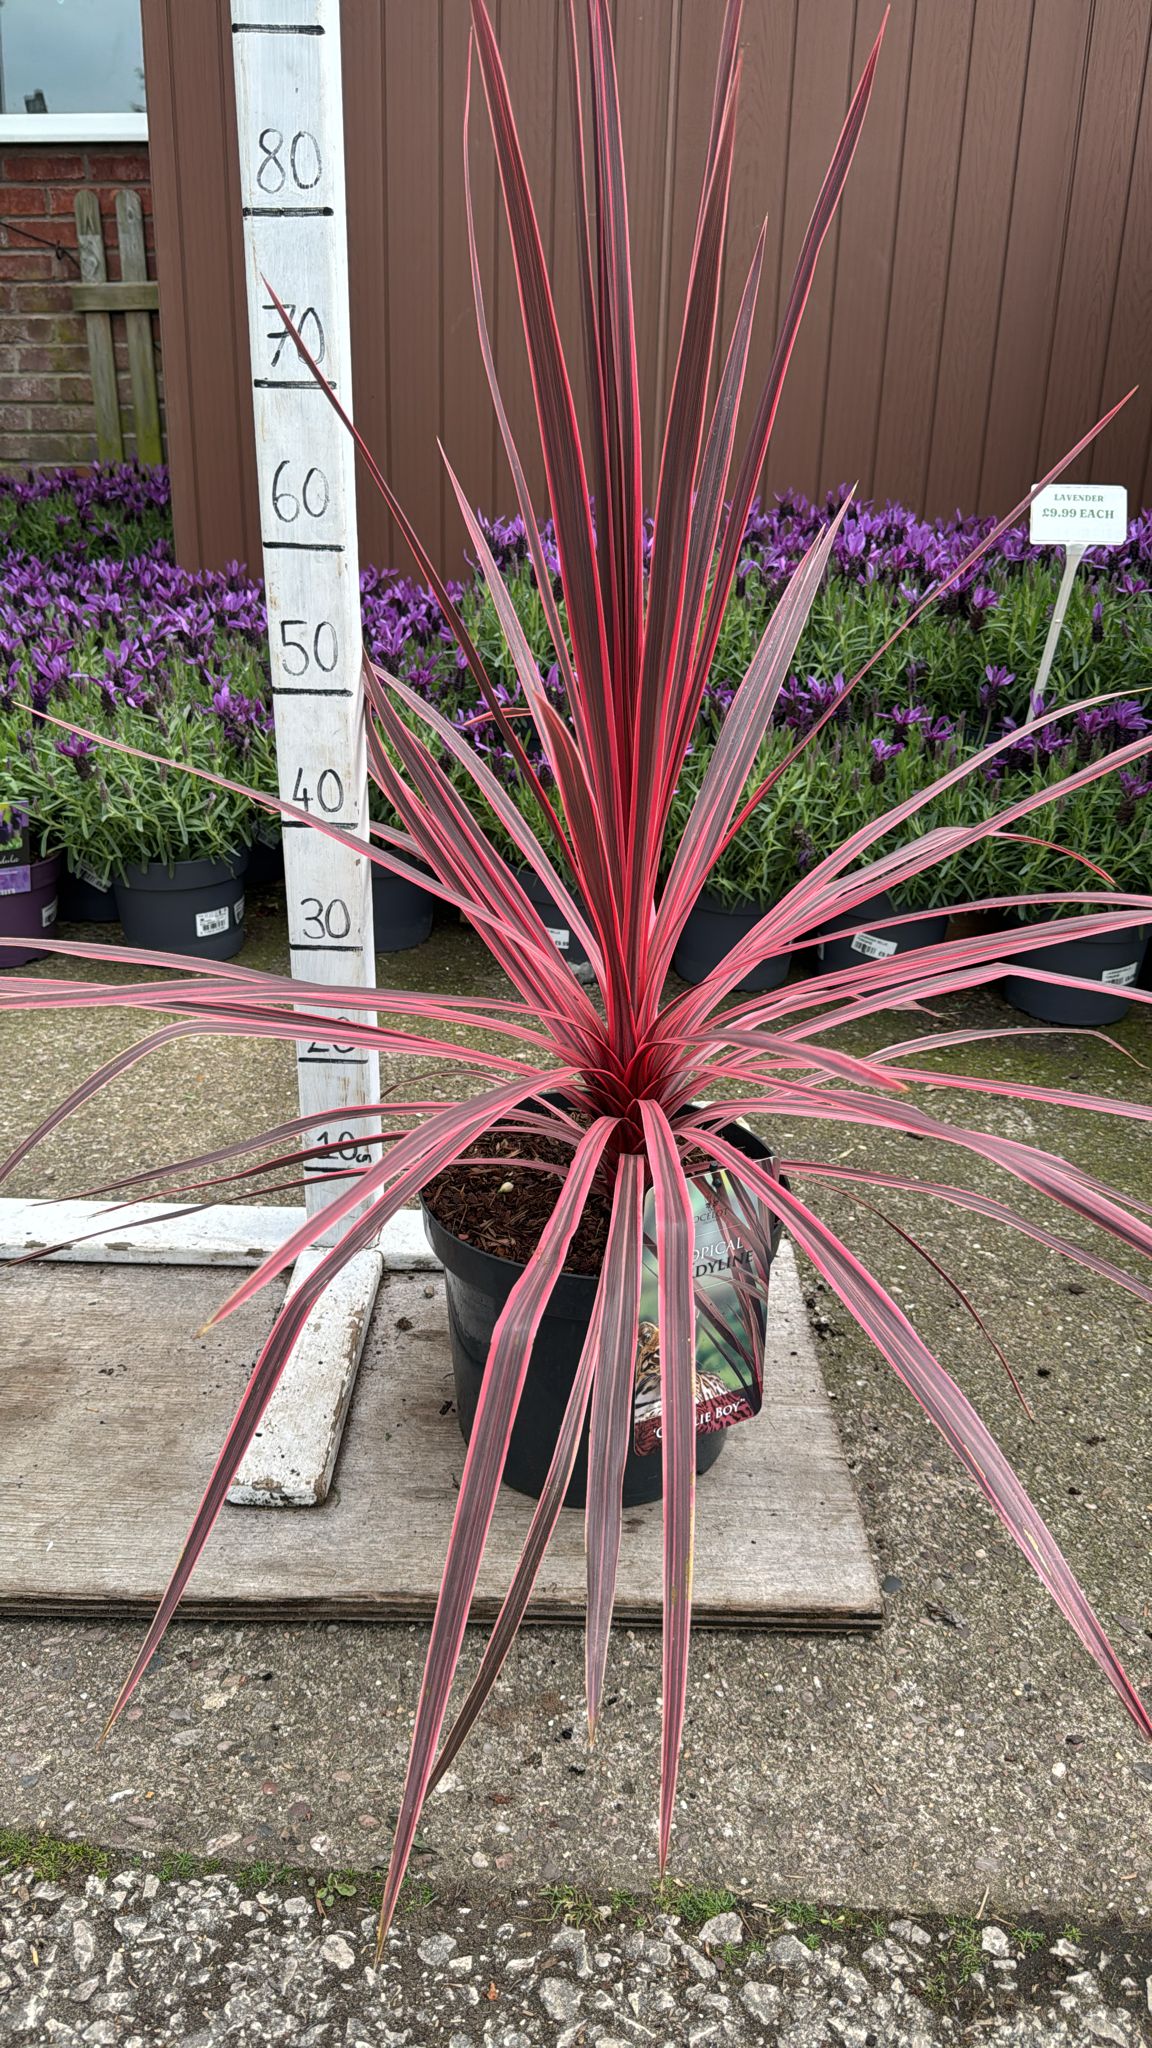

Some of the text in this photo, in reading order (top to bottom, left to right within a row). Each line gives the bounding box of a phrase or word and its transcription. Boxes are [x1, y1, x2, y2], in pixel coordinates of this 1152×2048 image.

[256, 127, 323, 194] 80
[262, 303, 325, 367] 70
[272, 460, 330, 523] 60
[1041, 507, 1115, 519] £9.99 EACH
[1053, 493, 1104, 503] LAVENDER
[280, 620, 339, 677] 50
[292, 767, 344, 813] 40
[300, 897, 351, 939] 30
[692, 1236, 744, 1262] OPICAL
[693, 1250, 754, 1279] DYLINE
